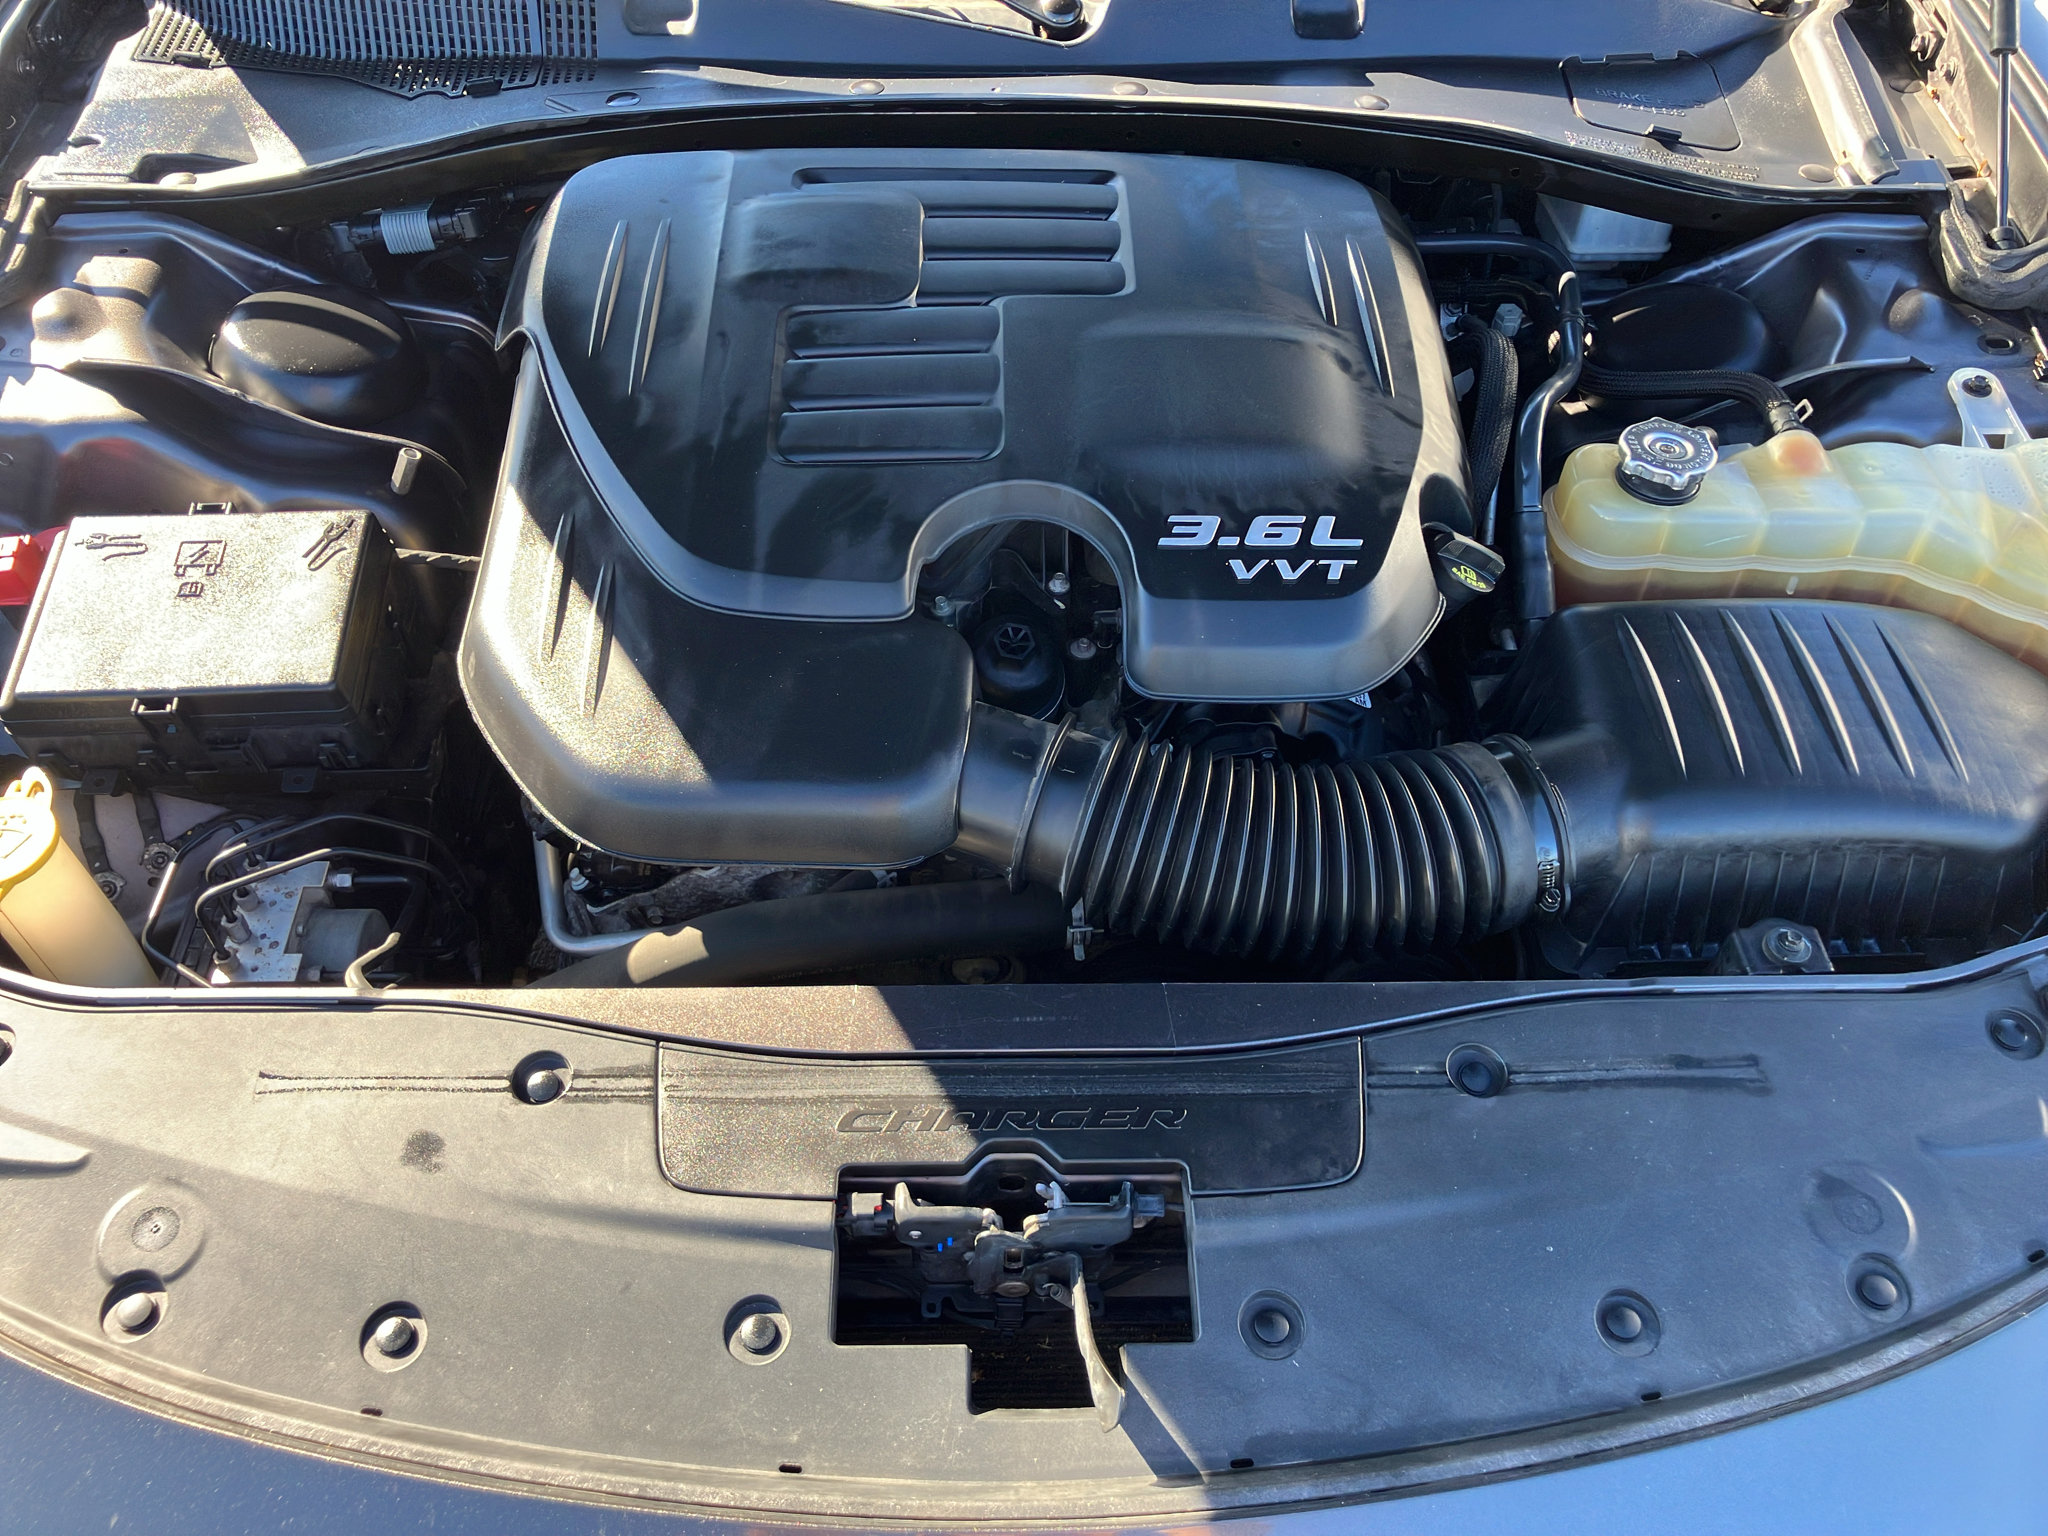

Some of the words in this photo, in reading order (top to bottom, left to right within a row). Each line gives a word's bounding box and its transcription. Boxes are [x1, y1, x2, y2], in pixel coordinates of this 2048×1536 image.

[1157, 514, 1364, 549] 3.6L
[1228, 559, 1358, 584] VVT
[835, 1106, 1188, 1134] CHARGER
